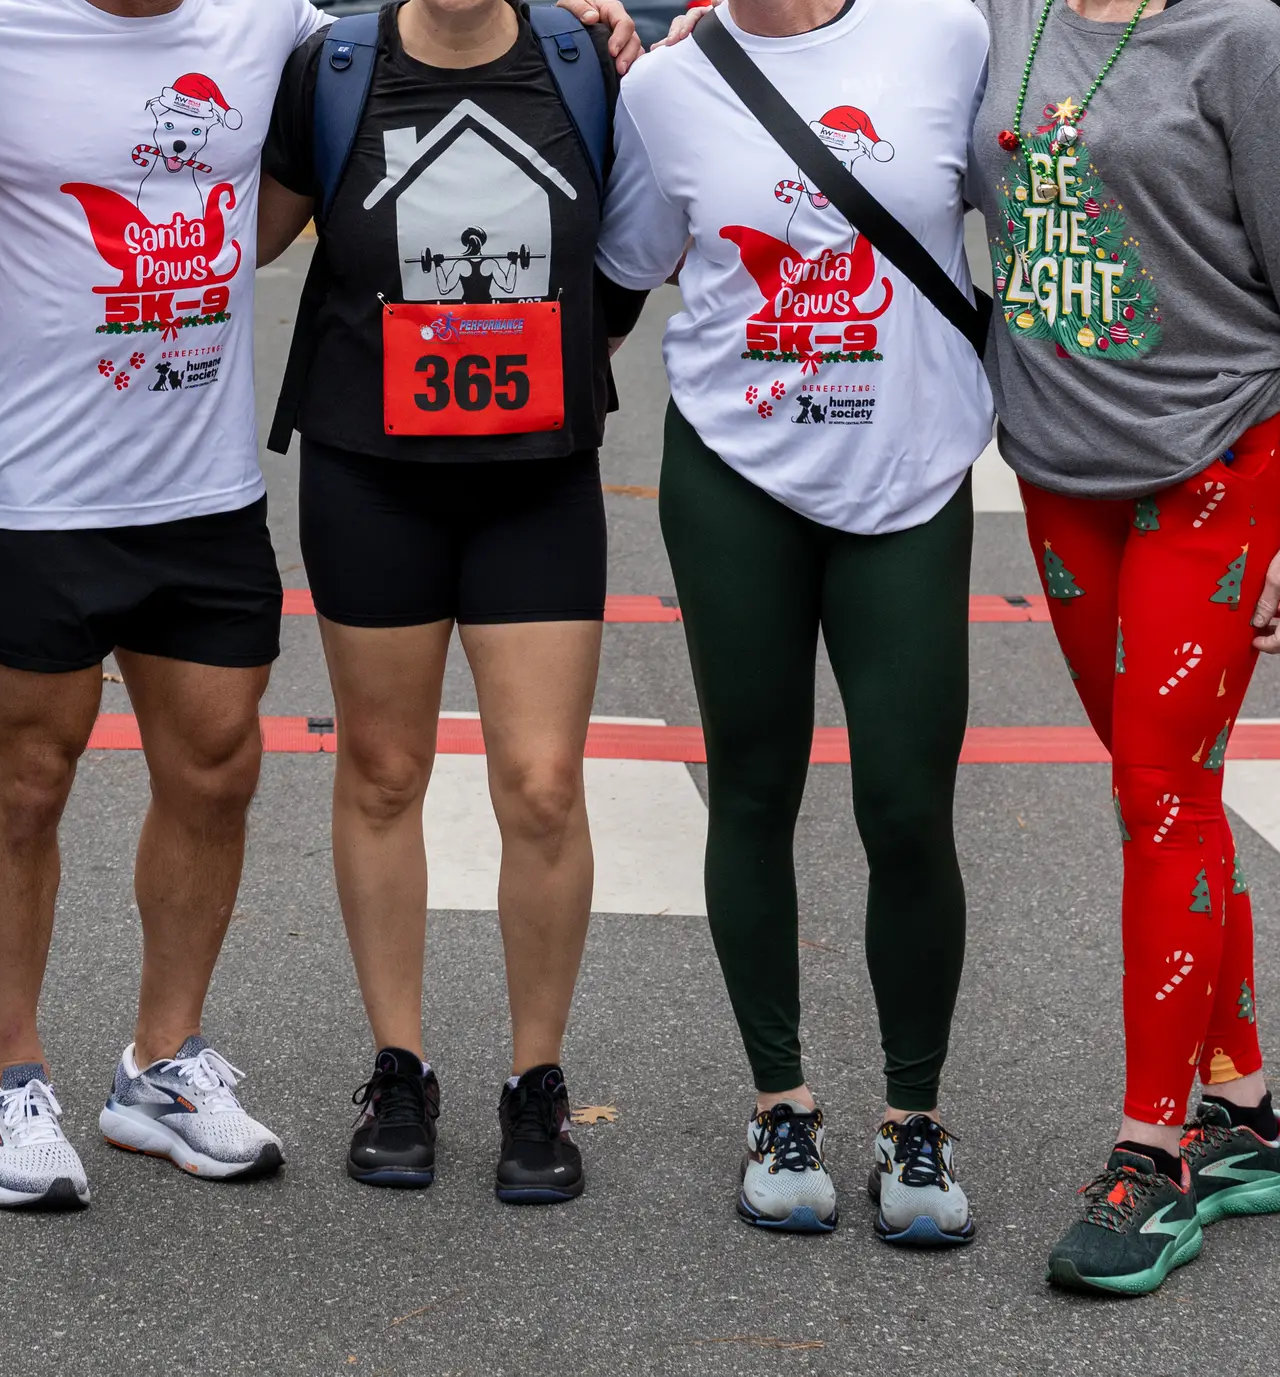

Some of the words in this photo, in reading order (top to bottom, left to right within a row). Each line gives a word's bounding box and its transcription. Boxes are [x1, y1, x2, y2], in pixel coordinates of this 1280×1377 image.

[1029, 152, 1079, 206] BE
[123, 215, 206, 254] Santa
[1022, 207, 1090, 255] THE
[136, 254, 208, 288] Paws
[779, 251, 852, 286] Santa
[105, 285, 230, 323] 5K-9
[774, 286, 850, 318] Paws
[459, 318, 525, 331] PERFORMANCE
[746, 323, 878, 352] 5K-9
[187, 368, 219, 382] society
[413, 354, 530, 412] 365
[802, 384, 876, 392] BENEFITING:
[829, 396, 876, 407] humane
[830, 408, 873, 420] society
